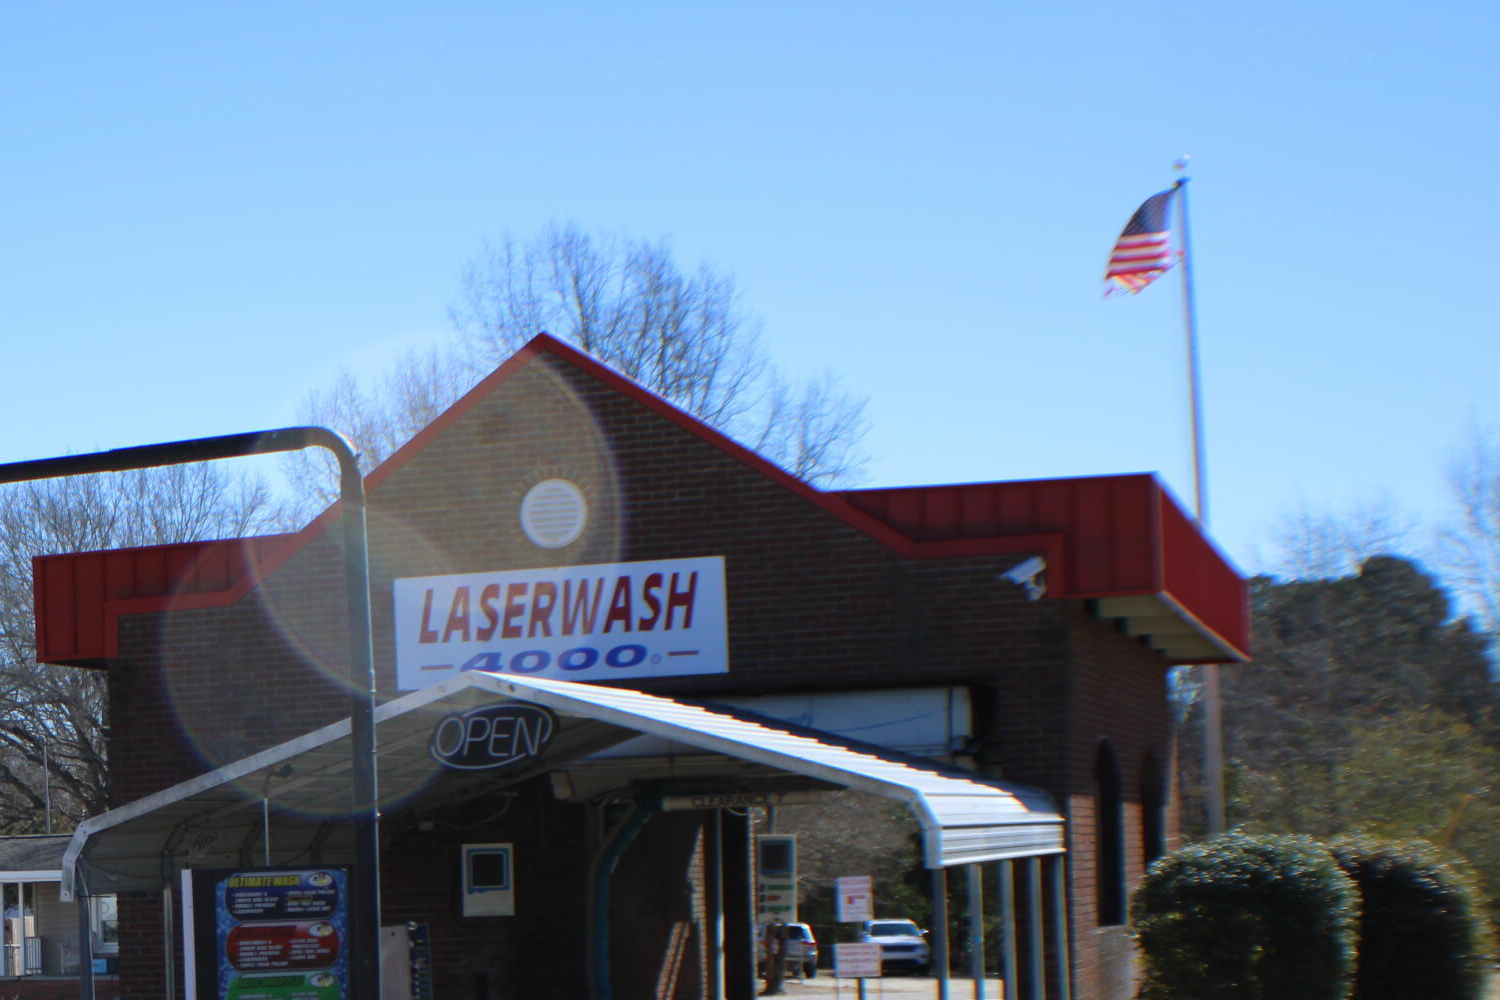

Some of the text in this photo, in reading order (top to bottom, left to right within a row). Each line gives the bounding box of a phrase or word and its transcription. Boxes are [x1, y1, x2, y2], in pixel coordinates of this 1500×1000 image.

[419, 570, 699, 644] LASERWASH
[460, 643, 648, 674] 4000
[435, 716, 543, 757] OPEN
